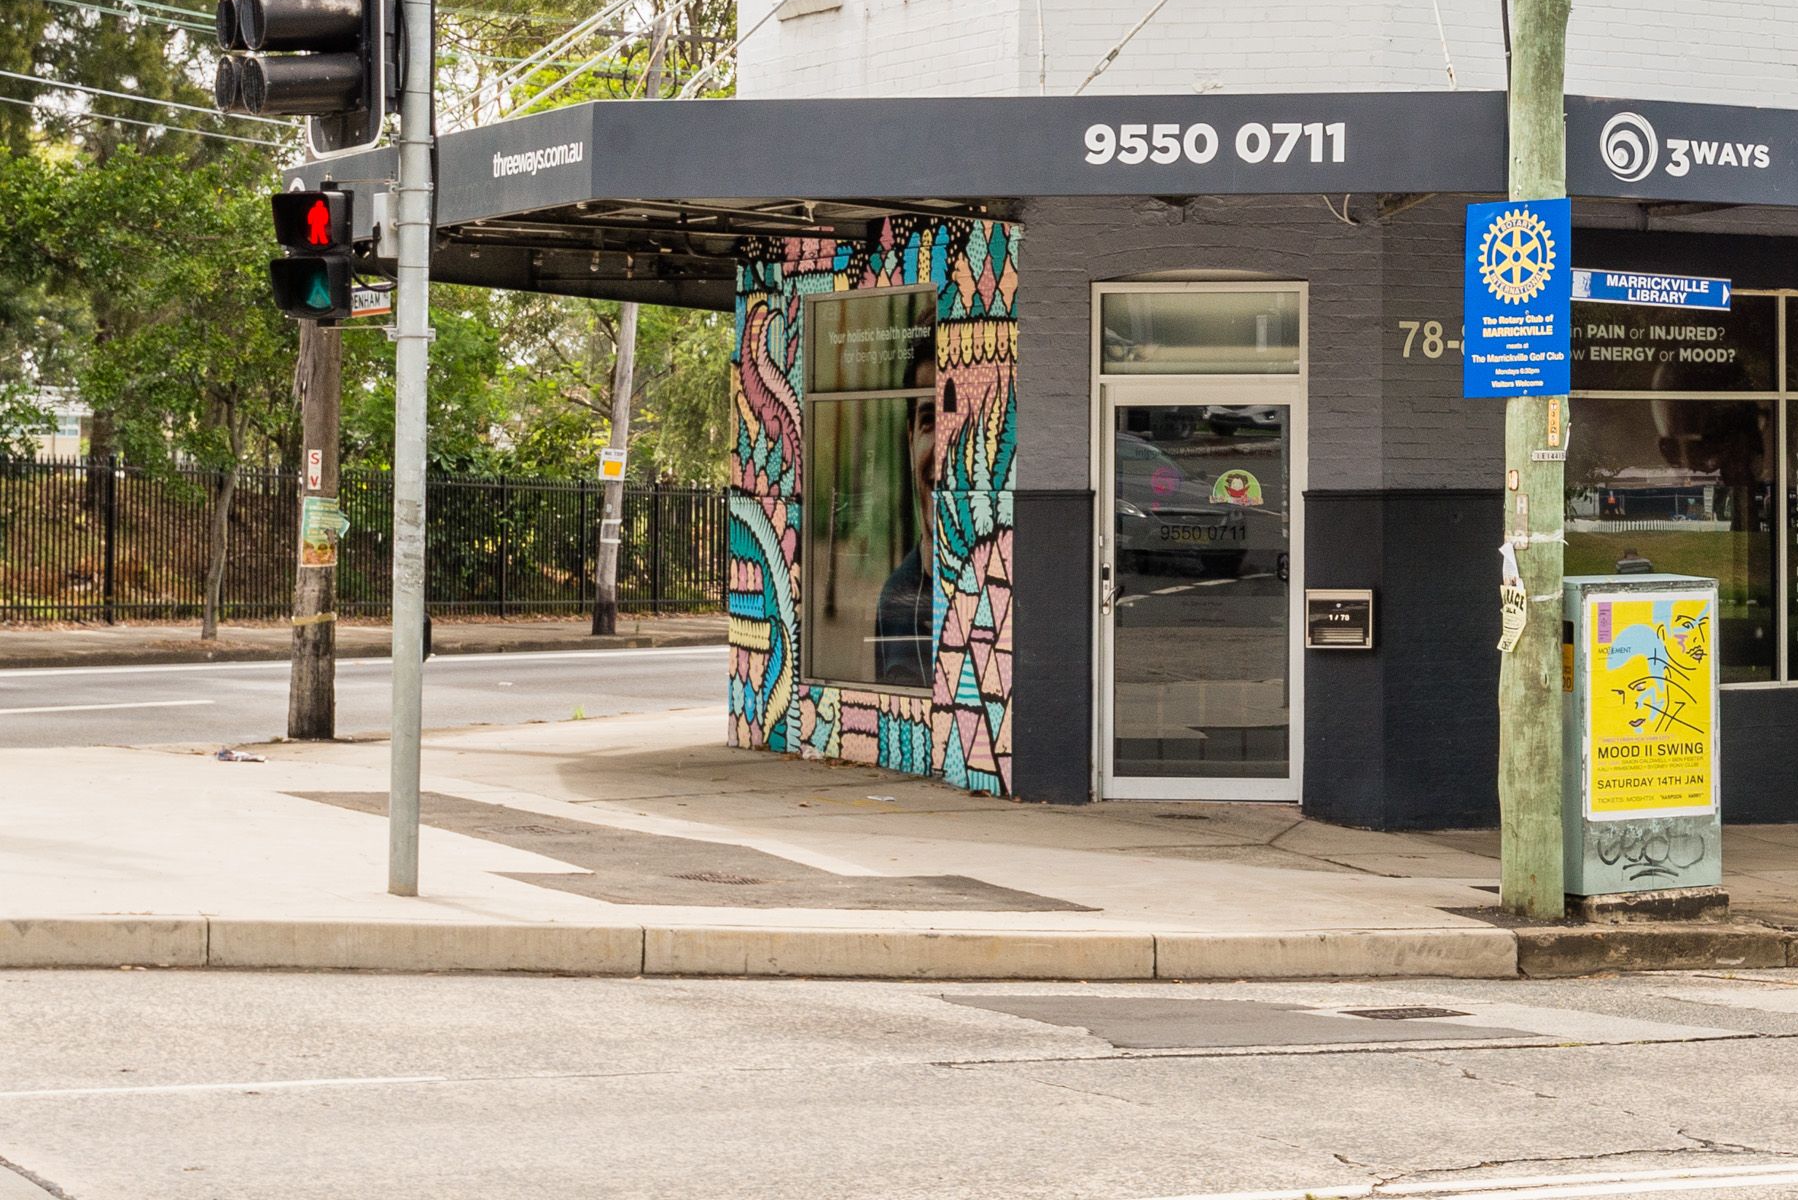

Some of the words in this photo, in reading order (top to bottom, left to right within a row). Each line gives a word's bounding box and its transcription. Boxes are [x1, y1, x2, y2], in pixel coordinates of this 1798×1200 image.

[1084, 123, 1218, 164] 9550
[1235, 123, 1345, 163] 0711
[493, 141, 583, 178] threeways.com.au
[1665, 140, 1770, 177] 3WAYS
[1501, 220, 1533, 232] ROTARY
[1490, 270, 1545, 295] INTERNATIONAL
[1606, 274, 1709, 293] MARRICKVILLE
[352, 293, 380, 309] ENHAM
[1628, 289, 1687, 304] LIBRARY
[1482, 317, 1497, 325] The
[1498, 316, 1524, 325] Rotary
[1525, 314, 1544, 323] Club
[1545, 313, 1554, 322] of
[876, 326, 900, 341] health
[902, 325, 931, 342] partner
[1399, 321, 1464, 358] 78-
[1482, 325, 1553, 338] MARRICKVILLE
[1587, 325, 1625, 339] PAIN
[1629, 327, 1645, 340] or
[1650, 327, 1725, 341] INJURED?
[1471, 354, 1486, 363] The
[1529, 352, 1545, 361] Golf
[1546, 351, 1565, 360] Club
[1590, 347, 1655, 362] ENERGY
[1659, 349, 1675, 362] or
[1679, 348, 1736, 363] MOOD?
[1160, 525, 1200, 541] 9550
[1207, 525, 1246, 540] 0711
[1598, 745, 1641, 759] MOOD
[1657, 742, 1704, 756] SWING
[1597, 777, 1654, 790] SATURDAY
[1658, 775, 1682, 786] 14TH
[1685, 774, 1704, 785] JAN
